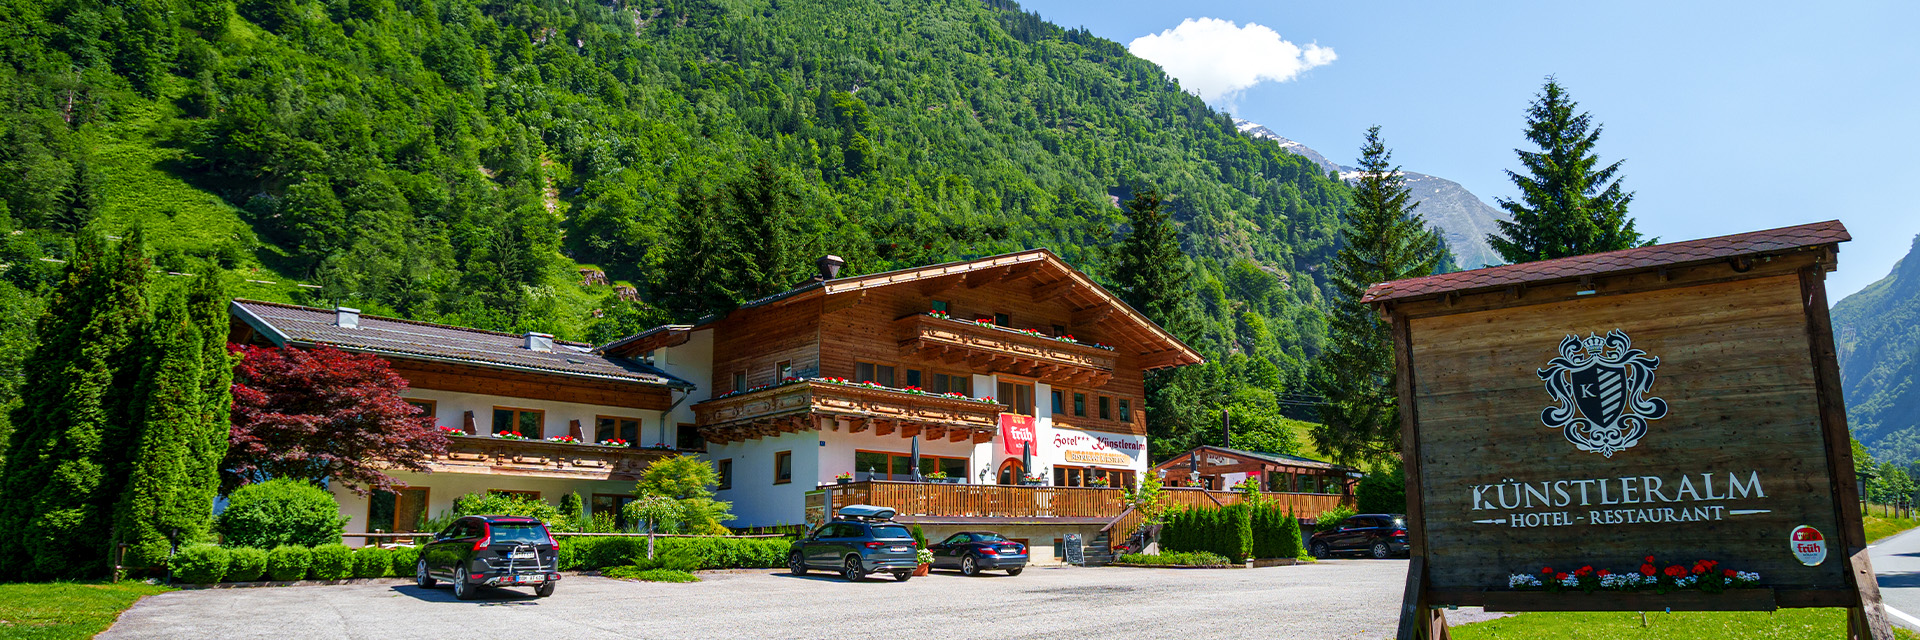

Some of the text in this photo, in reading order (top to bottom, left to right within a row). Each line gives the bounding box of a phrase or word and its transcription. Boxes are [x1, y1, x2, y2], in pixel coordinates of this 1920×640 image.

[1580, 383, 1597, 398] K
[1471, 470, 1768, 511] KÜNSTLERALM
[1511, 511, 1573, 528] HOTEL
[1590, 505, 1725, 525] RESTAURANT
